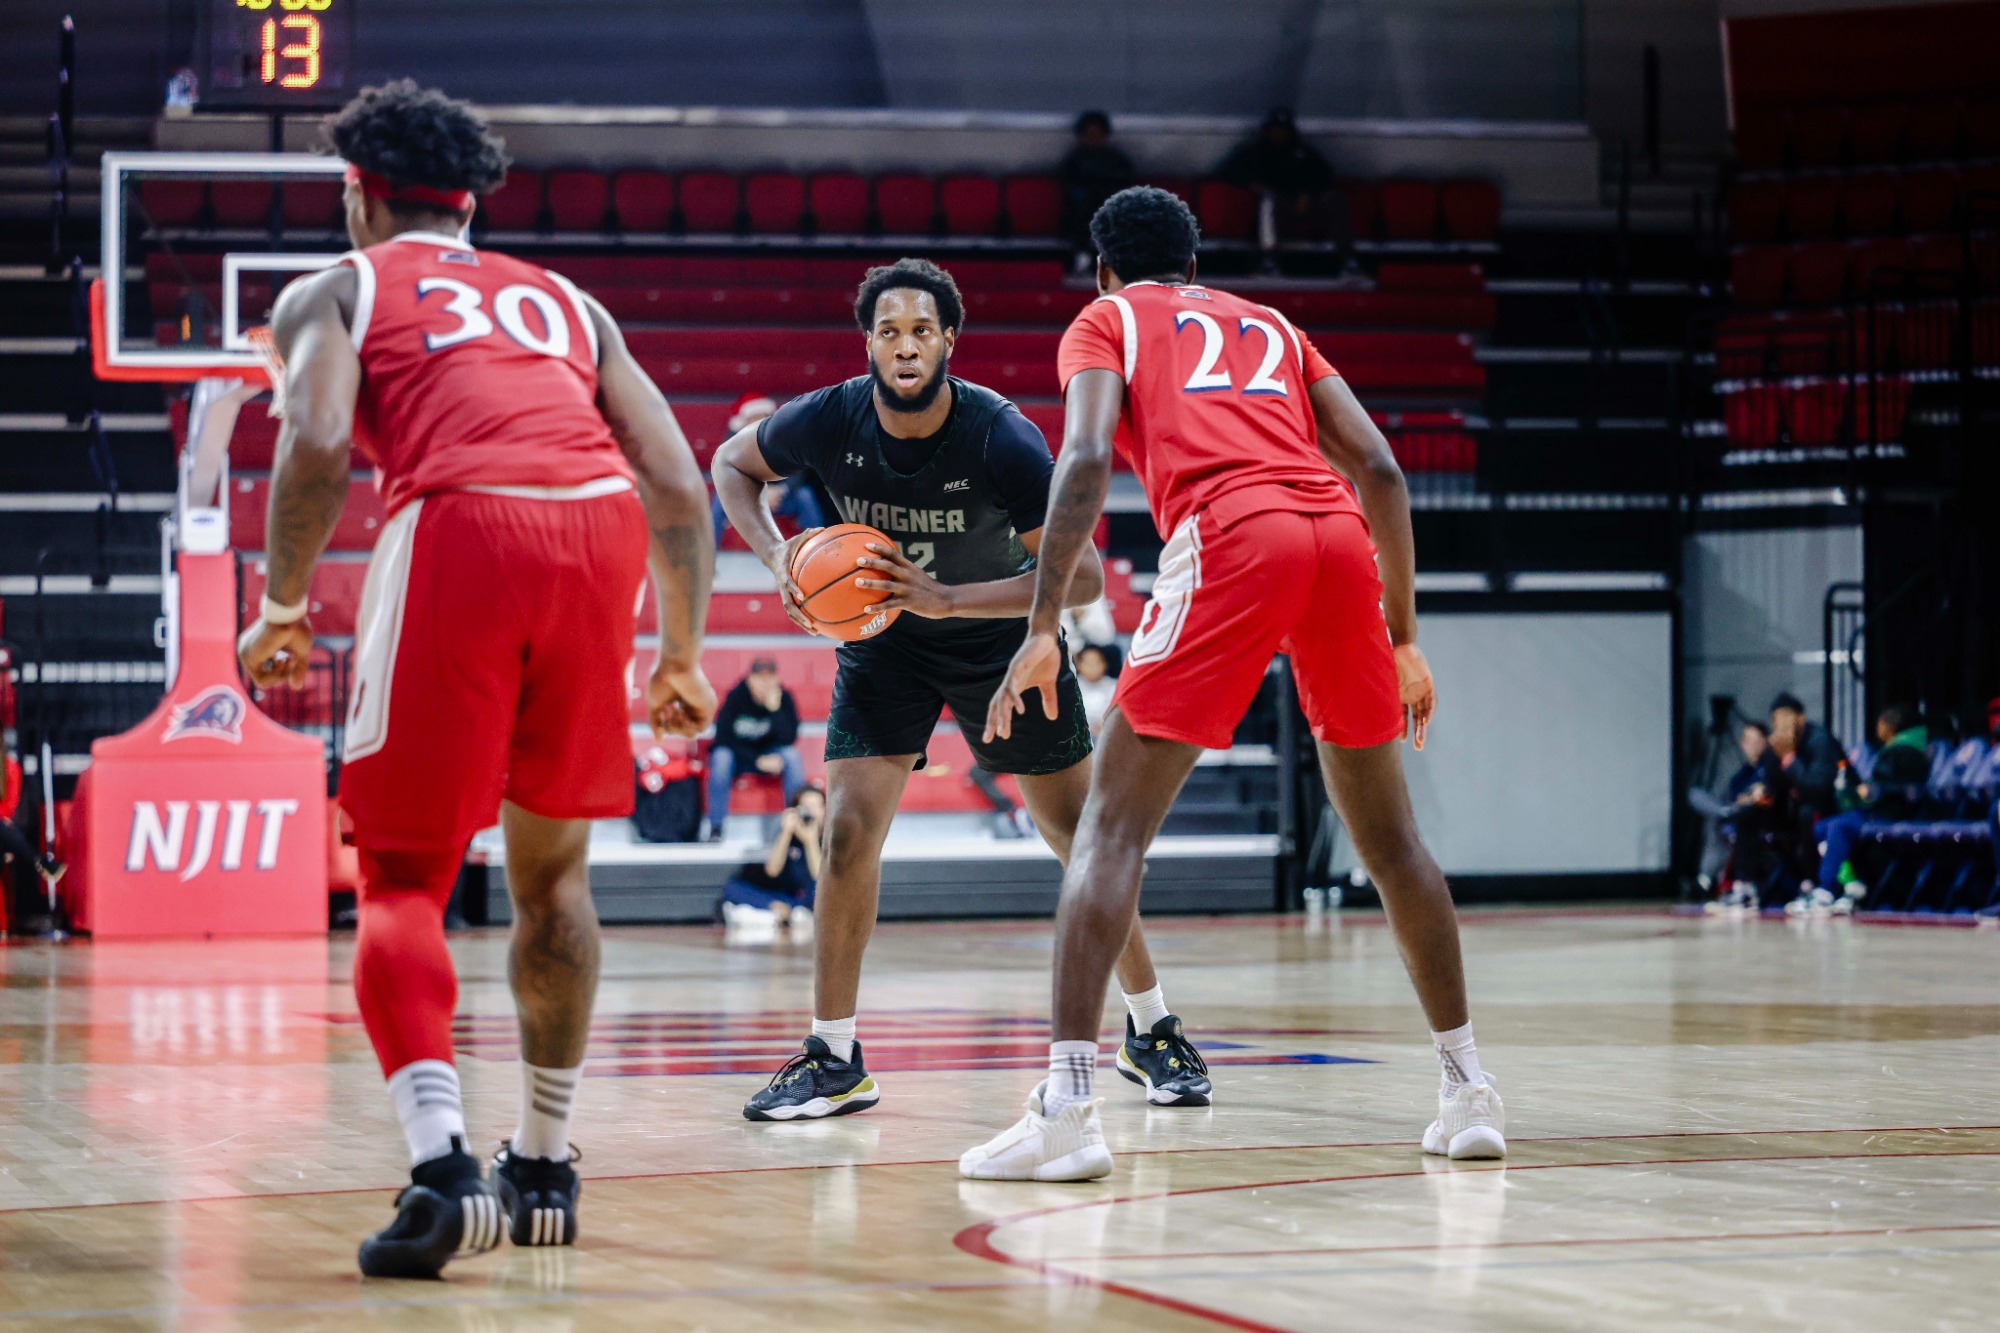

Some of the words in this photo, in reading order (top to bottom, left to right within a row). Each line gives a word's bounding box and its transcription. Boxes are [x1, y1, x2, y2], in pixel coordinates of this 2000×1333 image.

[261, 14, 320, 87] 13
[416, 276, 570, 358] 30
[1174, 310, 1288, 398] 22
[844, 496, 965, 533] WAGNER
[943, 478, 969, 491] NEC
[894, 541, 936, 579] 2
[125, 799, 298, 882] NJIT
